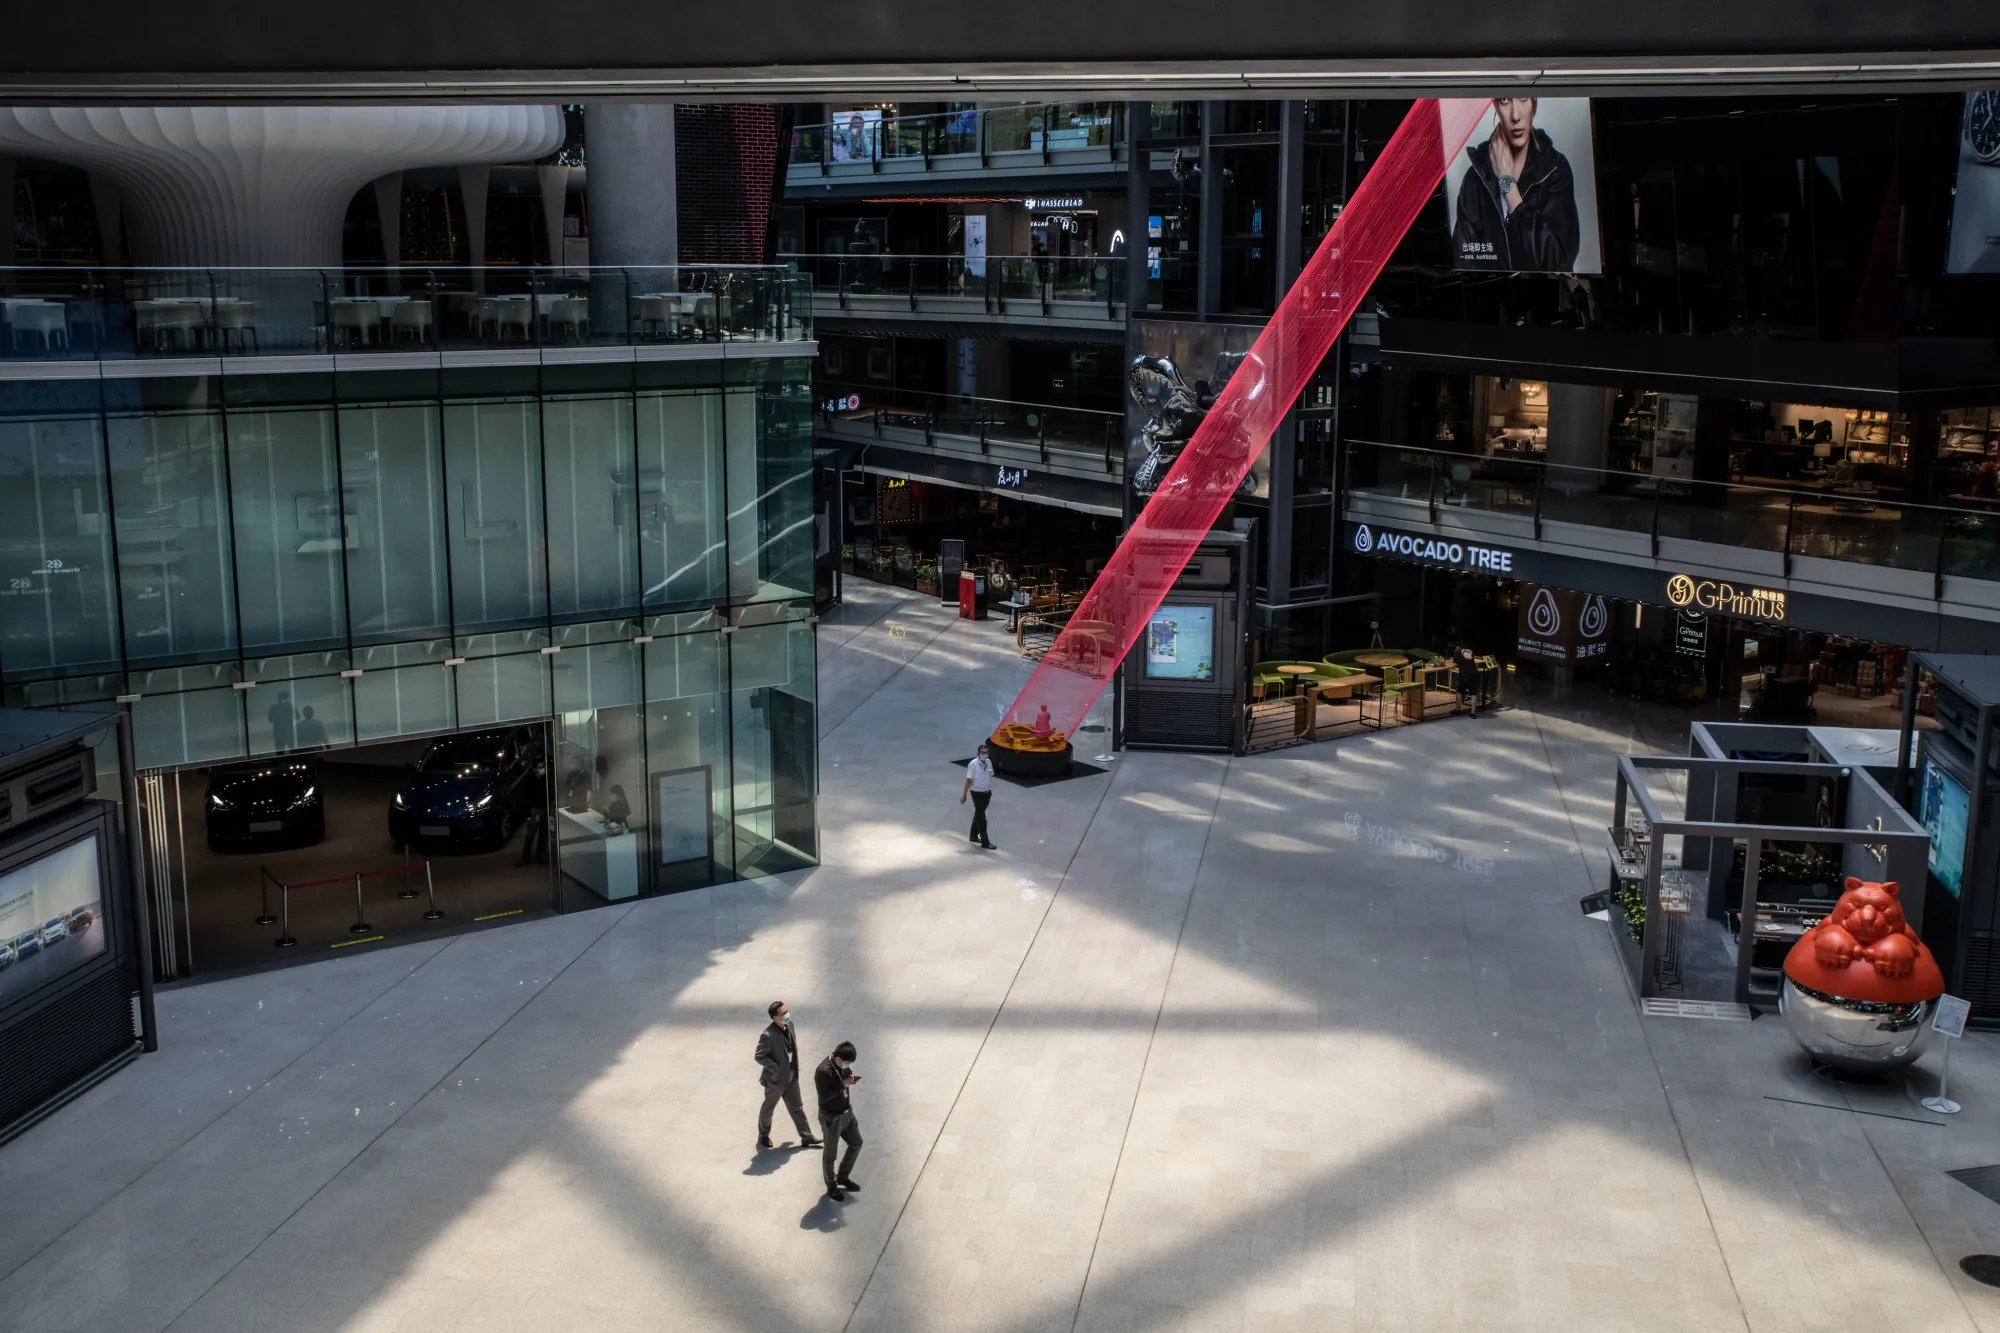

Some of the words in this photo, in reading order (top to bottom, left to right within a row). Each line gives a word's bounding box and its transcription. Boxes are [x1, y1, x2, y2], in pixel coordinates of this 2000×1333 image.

[1040, 199, 1083, 208] HASSELBLAD
[1377, 531, 1463, 564] AVOCADO
[1467, 545, 1513, 573] TREE
[1543, 642, 1566, 652] ORIGINAL
[1542, 649, 1567, 659] COUNTER
